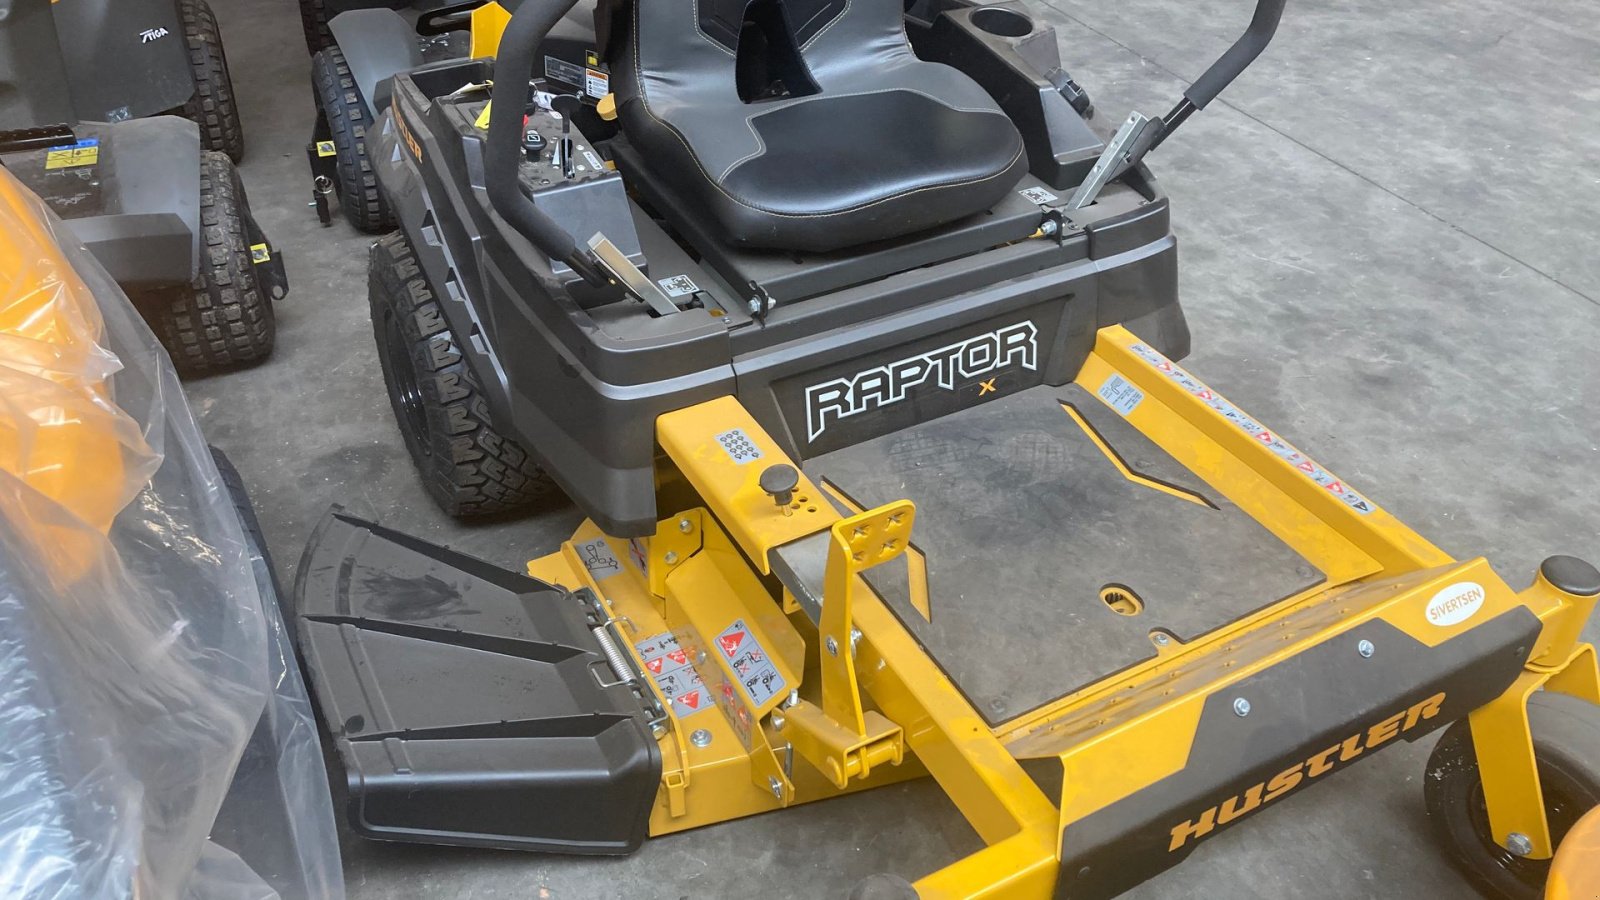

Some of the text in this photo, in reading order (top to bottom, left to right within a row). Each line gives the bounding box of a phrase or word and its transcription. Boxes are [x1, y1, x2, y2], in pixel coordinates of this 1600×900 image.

[139, 27, 169, 44] STIGA
[805, 320, 1038, 443] RAPTOR
[1430, 587, 1482, 620] SIVERTSEN
[1168, 692, 1446, 852] HUSTLER
